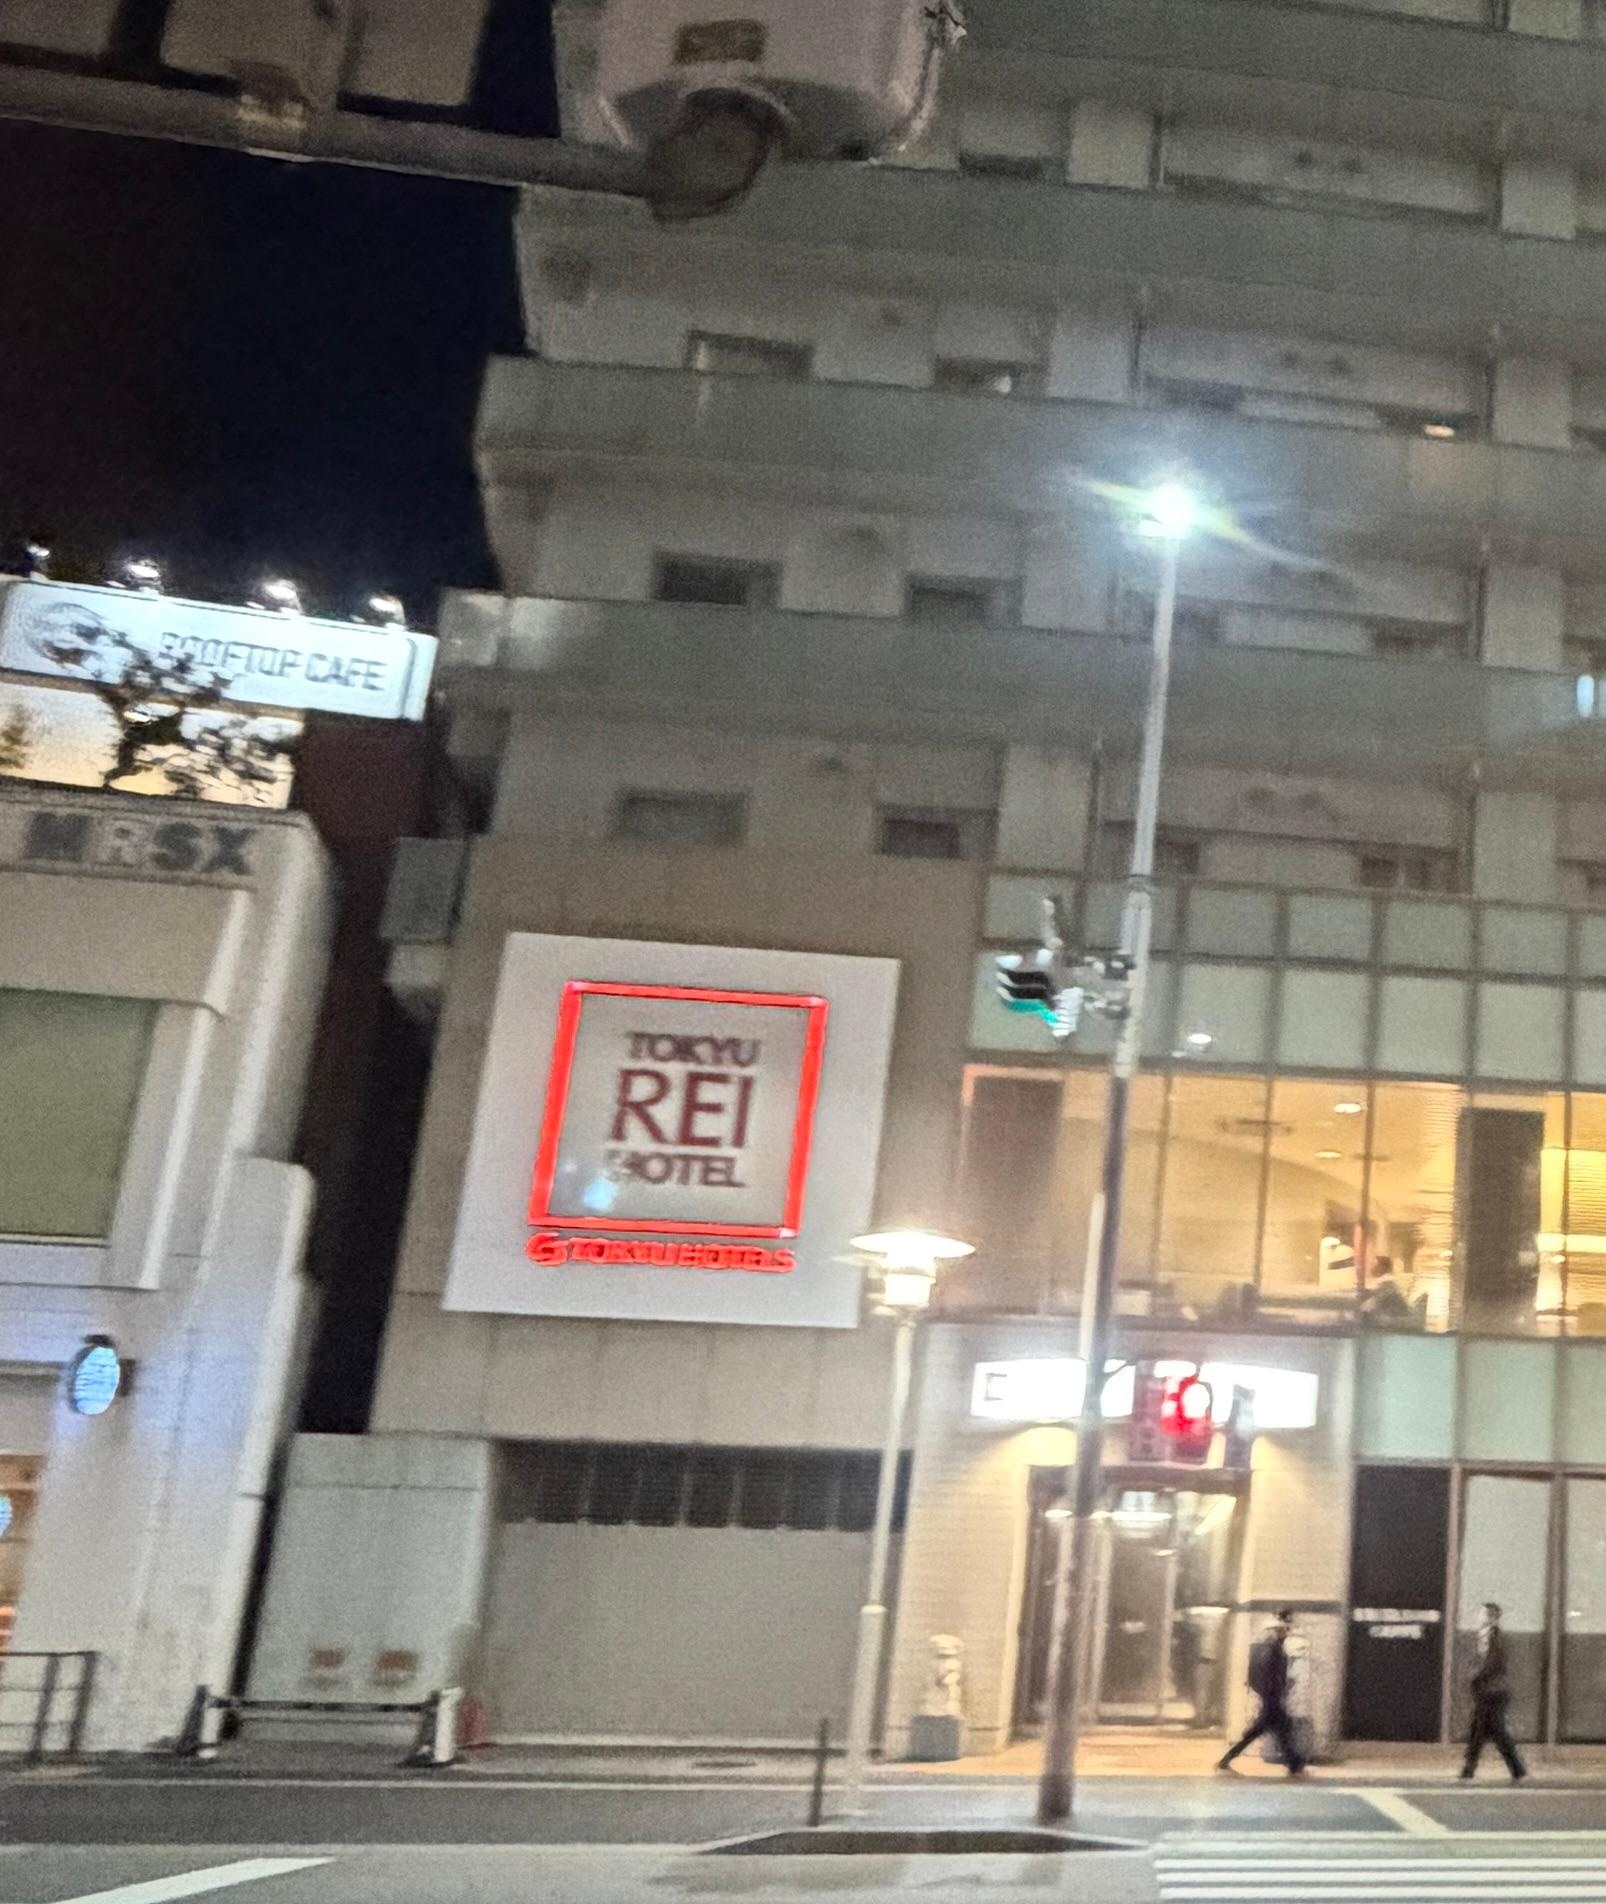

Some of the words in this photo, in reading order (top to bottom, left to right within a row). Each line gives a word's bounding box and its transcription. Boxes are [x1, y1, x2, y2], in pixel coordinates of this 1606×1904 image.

[304, 652, 387, 691] CAFE
[627, 1031, 762, 1068] TOKYU
[611, 1067, 753, 1148] REI
[607, 1148, 746, 1188] HOTEL
